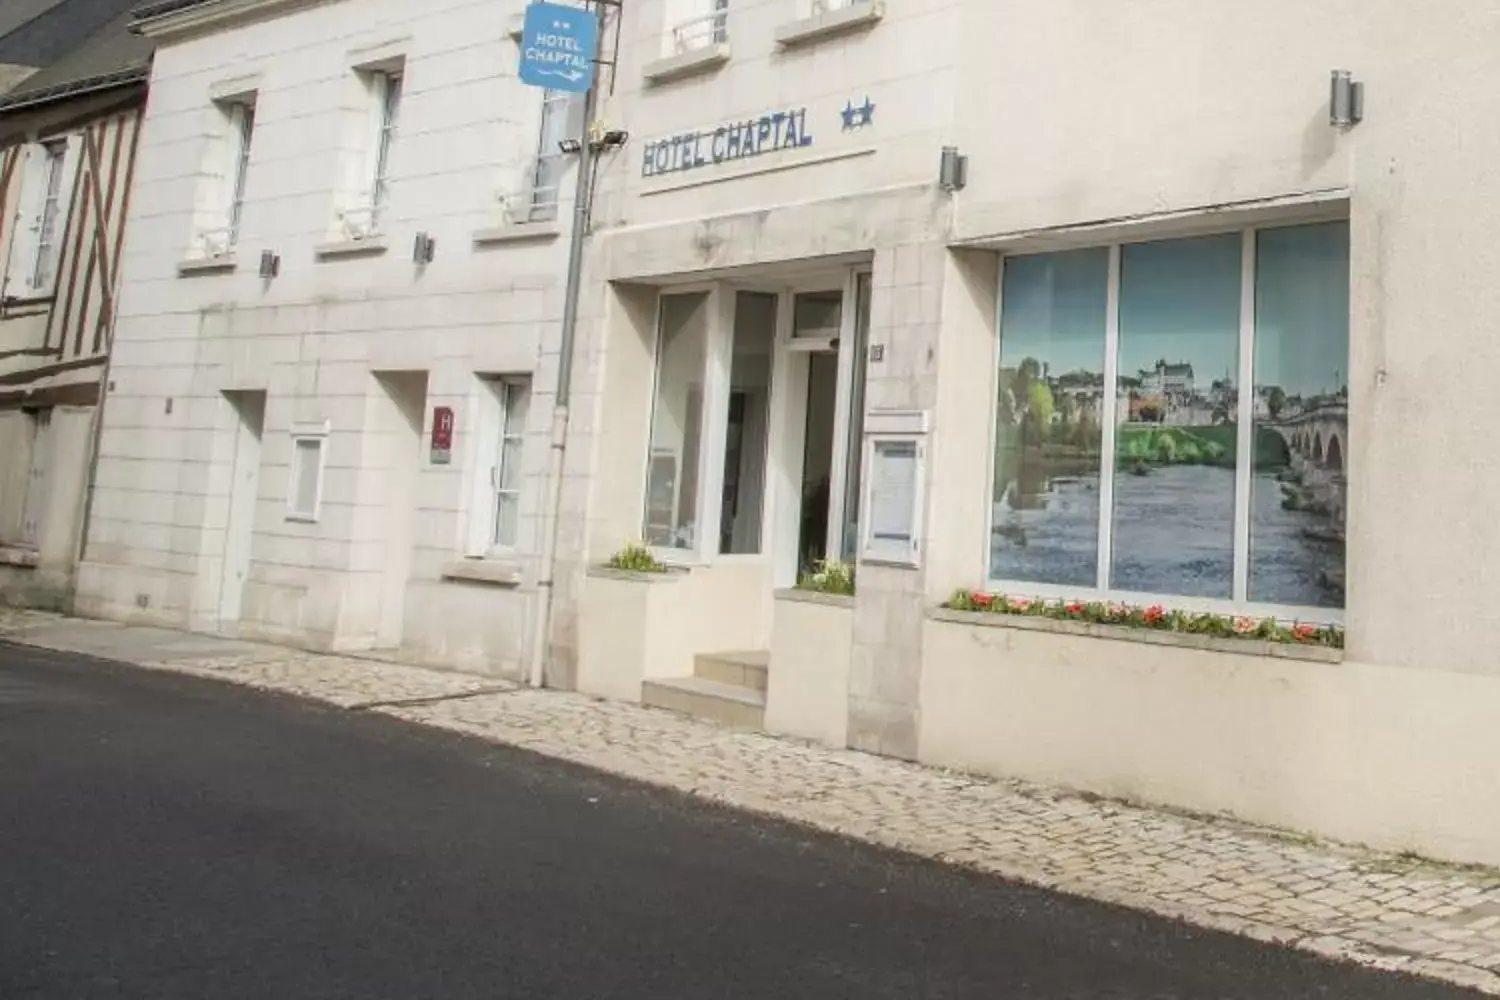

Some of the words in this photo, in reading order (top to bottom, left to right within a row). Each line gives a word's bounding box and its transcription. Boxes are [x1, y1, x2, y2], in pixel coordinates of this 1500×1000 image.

[535, 31, 583, 51] HOTEL
[525, 47, 589, 70] CHAPTAL
[642, 130, 705, 178] HOTEL
[711, 107, 813, 164] CHAPTAL
[441, 413, 451, 432] H
